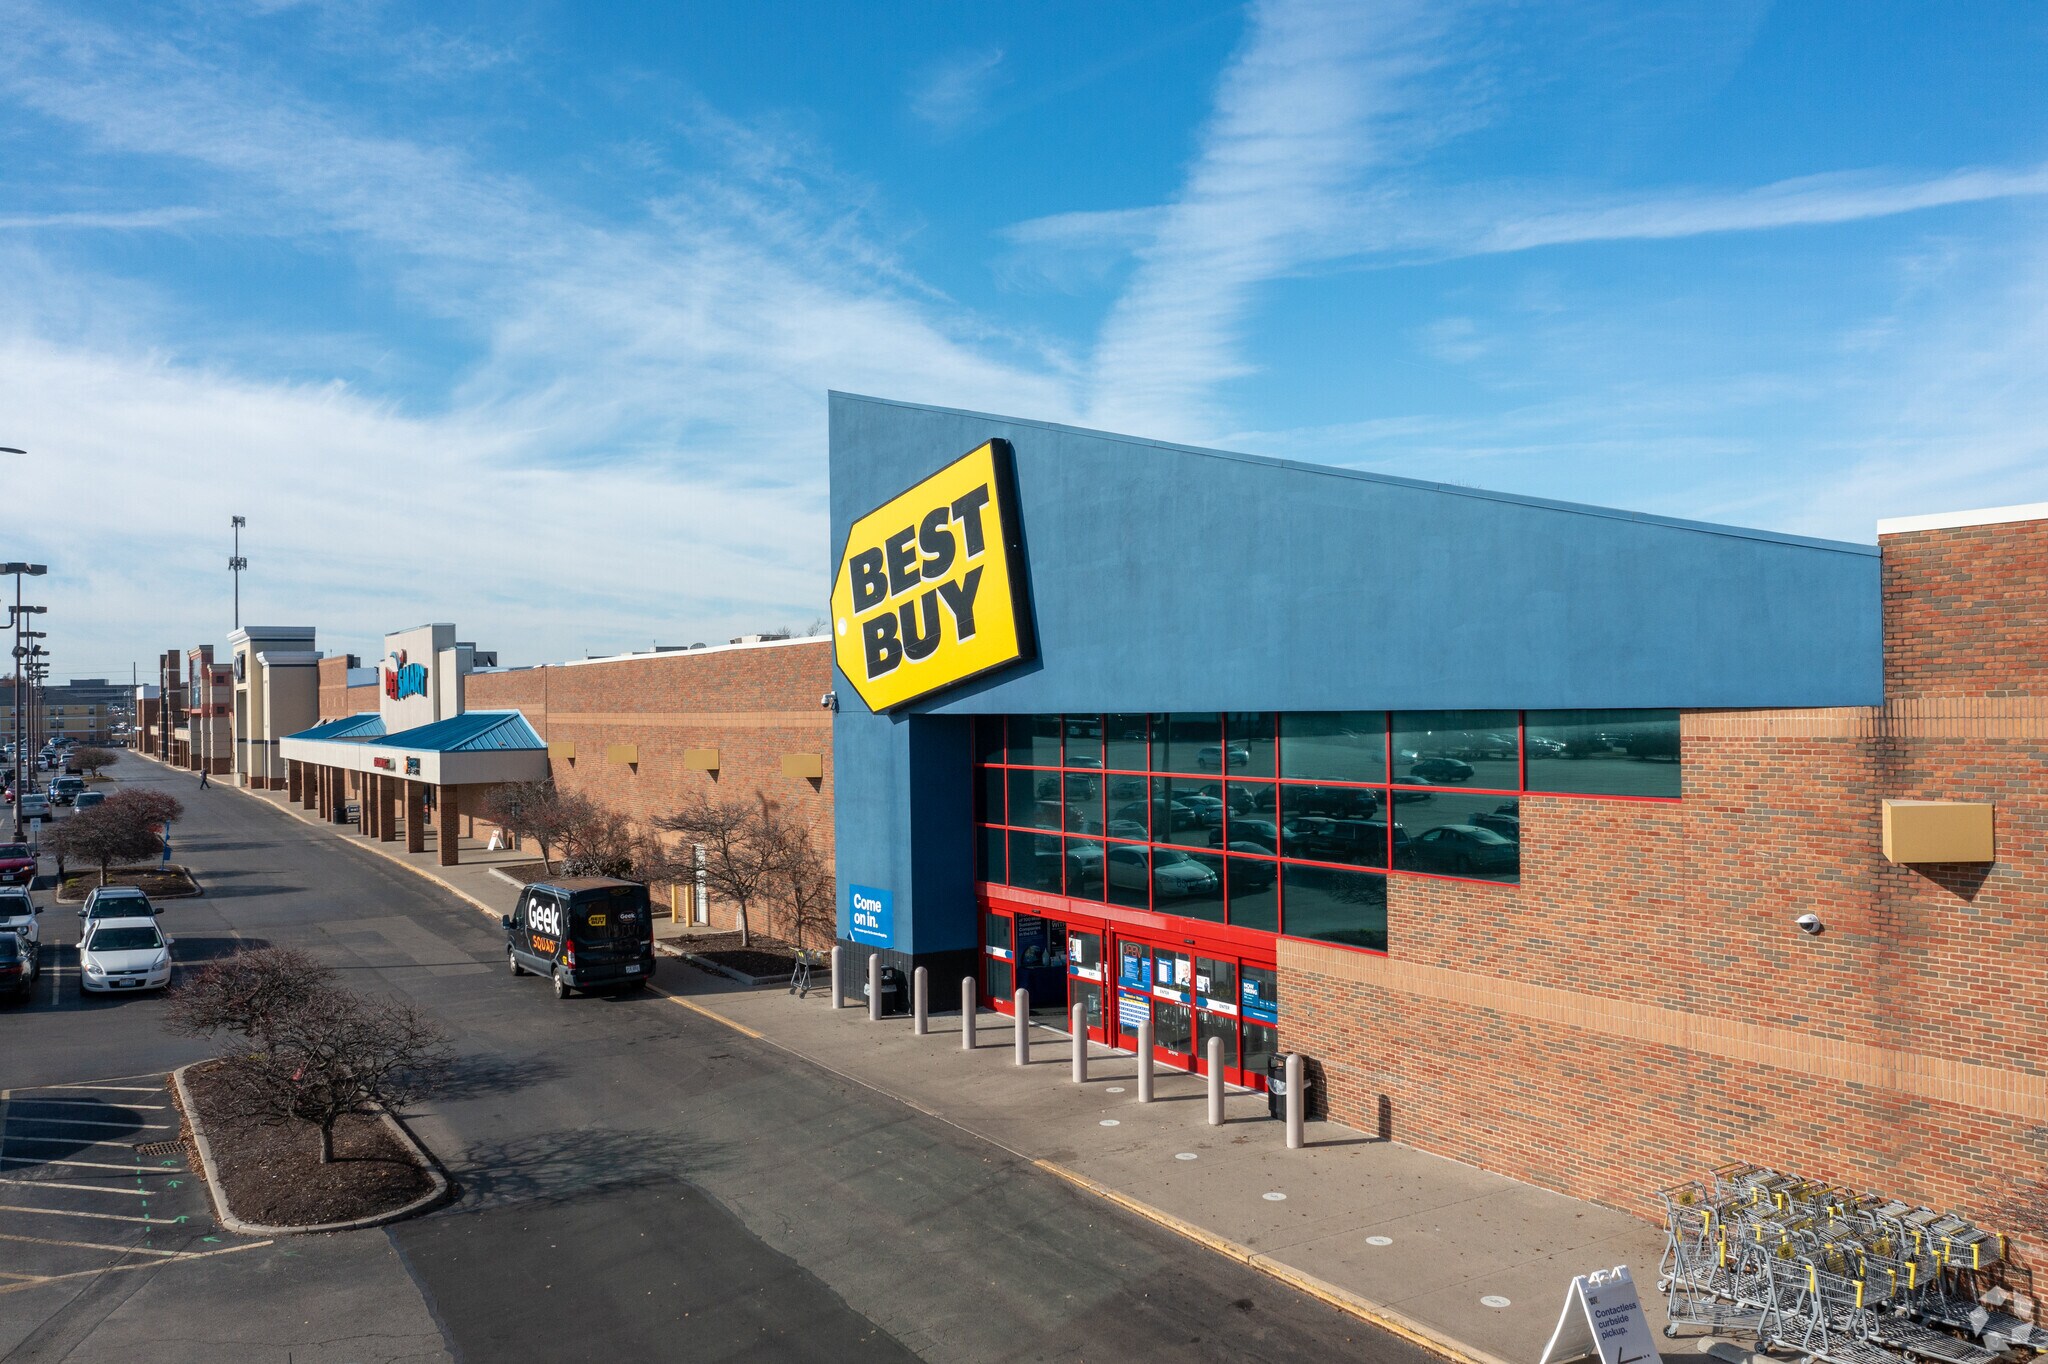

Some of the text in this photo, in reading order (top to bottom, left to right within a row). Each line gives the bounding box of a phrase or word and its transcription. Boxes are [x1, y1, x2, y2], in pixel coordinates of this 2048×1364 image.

[850, 482, 990, 615] BEST
[862, 564, 985, 680] BUY
[853, 893, 882, 913] Come
[528, 898, 560, 936] Geek
[854, 911, 878, 928] on in.
[532, 935, 556, 954] SQUAD
[1123, 943, 1141, 958] OPEN
[1595, 1302, 1637, 1319] Contactless
[1598, 1314, 1630, 1329] curbside
[1601, 1327, 1628, 1341] pickup.
